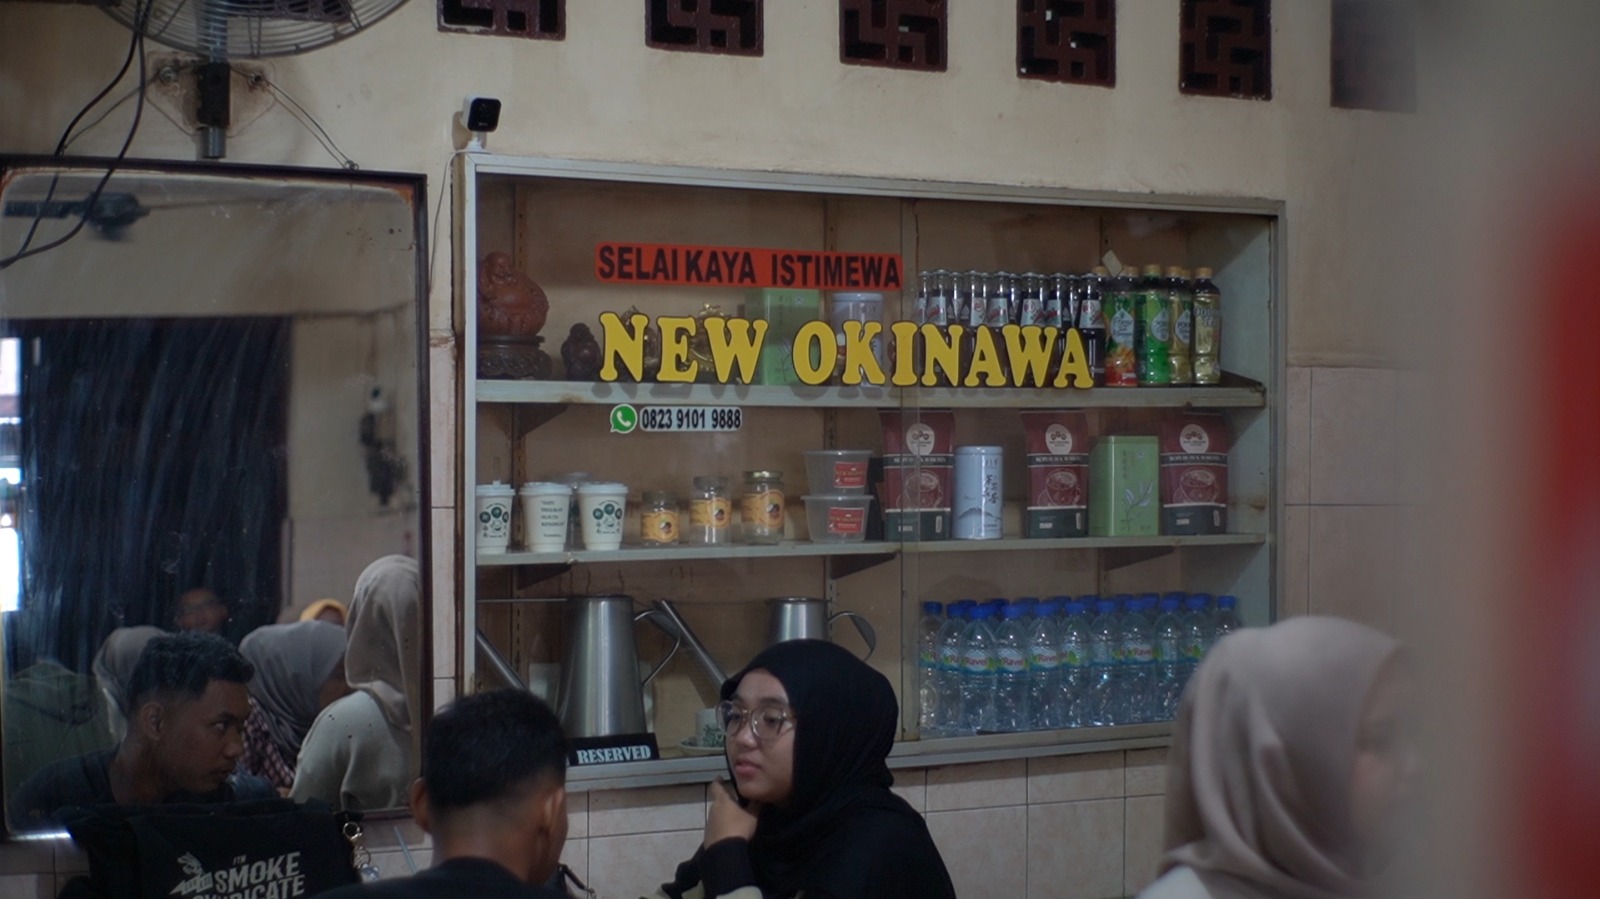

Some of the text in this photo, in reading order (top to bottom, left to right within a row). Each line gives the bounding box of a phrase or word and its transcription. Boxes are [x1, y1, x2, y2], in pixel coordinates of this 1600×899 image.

[598, 245, 901, 288] SELAI KAYA ISTIMEWA
[598, 311, 1095, 389] NEW OKINAWA
[641, 409, 742, 430] 0823 9101 9888
[576, 745, 651, 765] RESERVED
[213, 851, 301, 893] SMOKE
